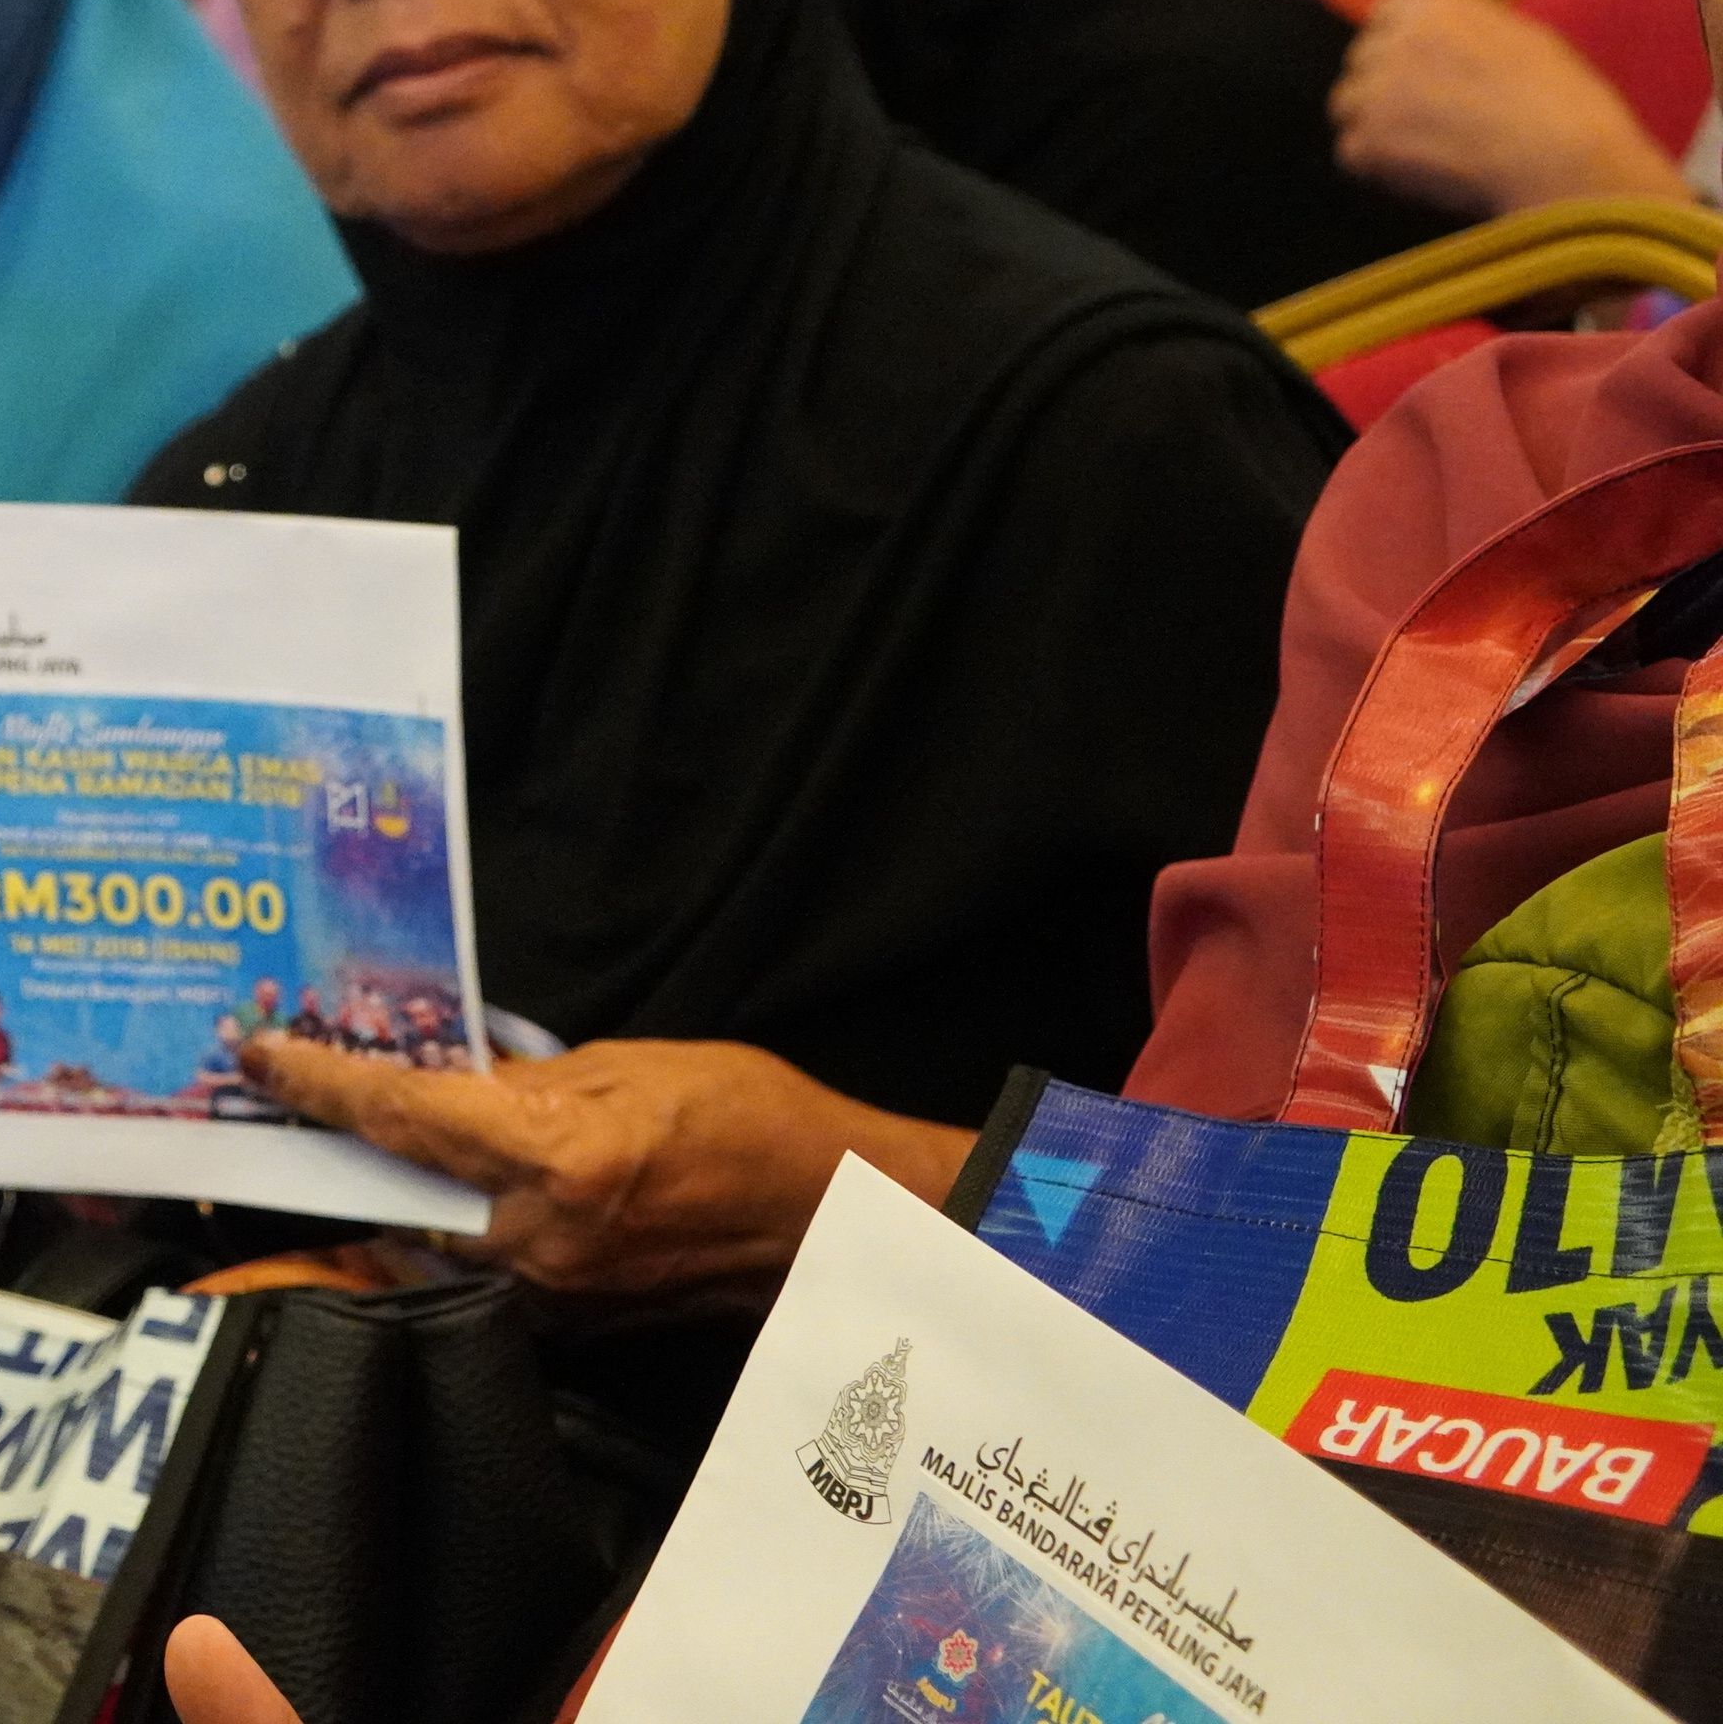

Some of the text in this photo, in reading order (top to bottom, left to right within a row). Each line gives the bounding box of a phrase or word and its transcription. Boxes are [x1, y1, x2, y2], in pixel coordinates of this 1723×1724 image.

[807, 1458, 874, 1521] MBPJ
[1319, 1399, 1654, 1506] BAUCAR
[921, 1446, 1267, 1716] MAJLIS BANDARAYA PETALING JAYA
